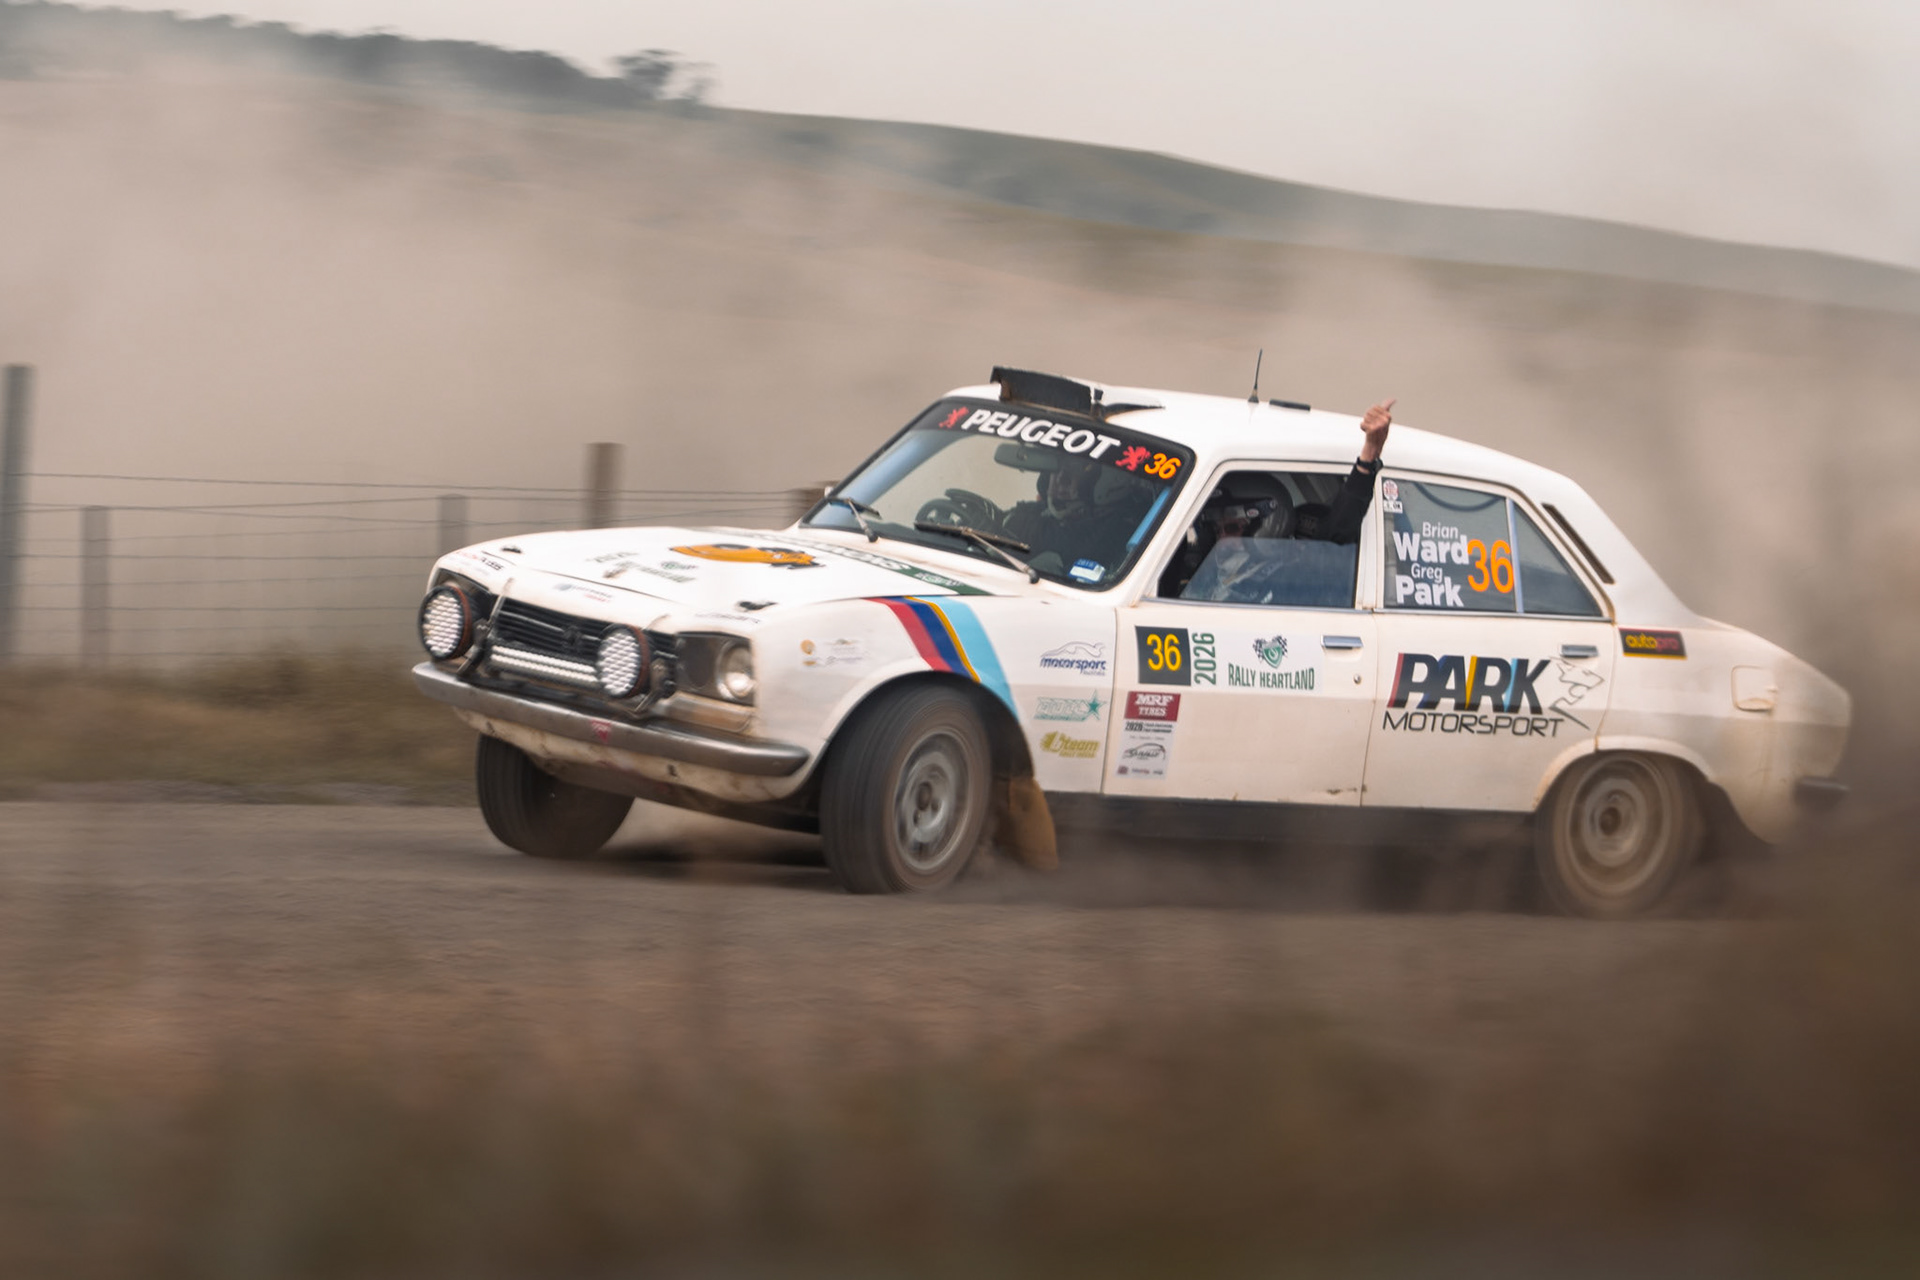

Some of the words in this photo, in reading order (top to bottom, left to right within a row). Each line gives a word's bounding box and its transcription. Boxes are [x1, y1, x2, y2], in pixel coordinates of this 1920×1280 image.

[961, 408, 1121, 460] PEUGEOT
[1144, 453, 1182, 481] 36
[1421, 521, 1459, 540] Brian
[1392, 531, 1470, 565] Ward
[1411, 562, 1443, 581] Greg
[1466, 539, 1515, 593] 36
[1395, 575, 1465, 608] Park
[1039, 657, 1107, 675] motorsport
[1146, 633, 1183, 672] 36
[1192, 632, 1217, 686] 2026
[1228, 663, 1257, 688] RALLY
[1259, 667, 1316, 691] HEARTLAND
[1386, 652, 1552, 715] PARK
[1135, 692, 1174, 707] MRF
[1138, 706, 1167, 717] TYRES
[1382, 711, 1565, 738] MOTORSPORT
